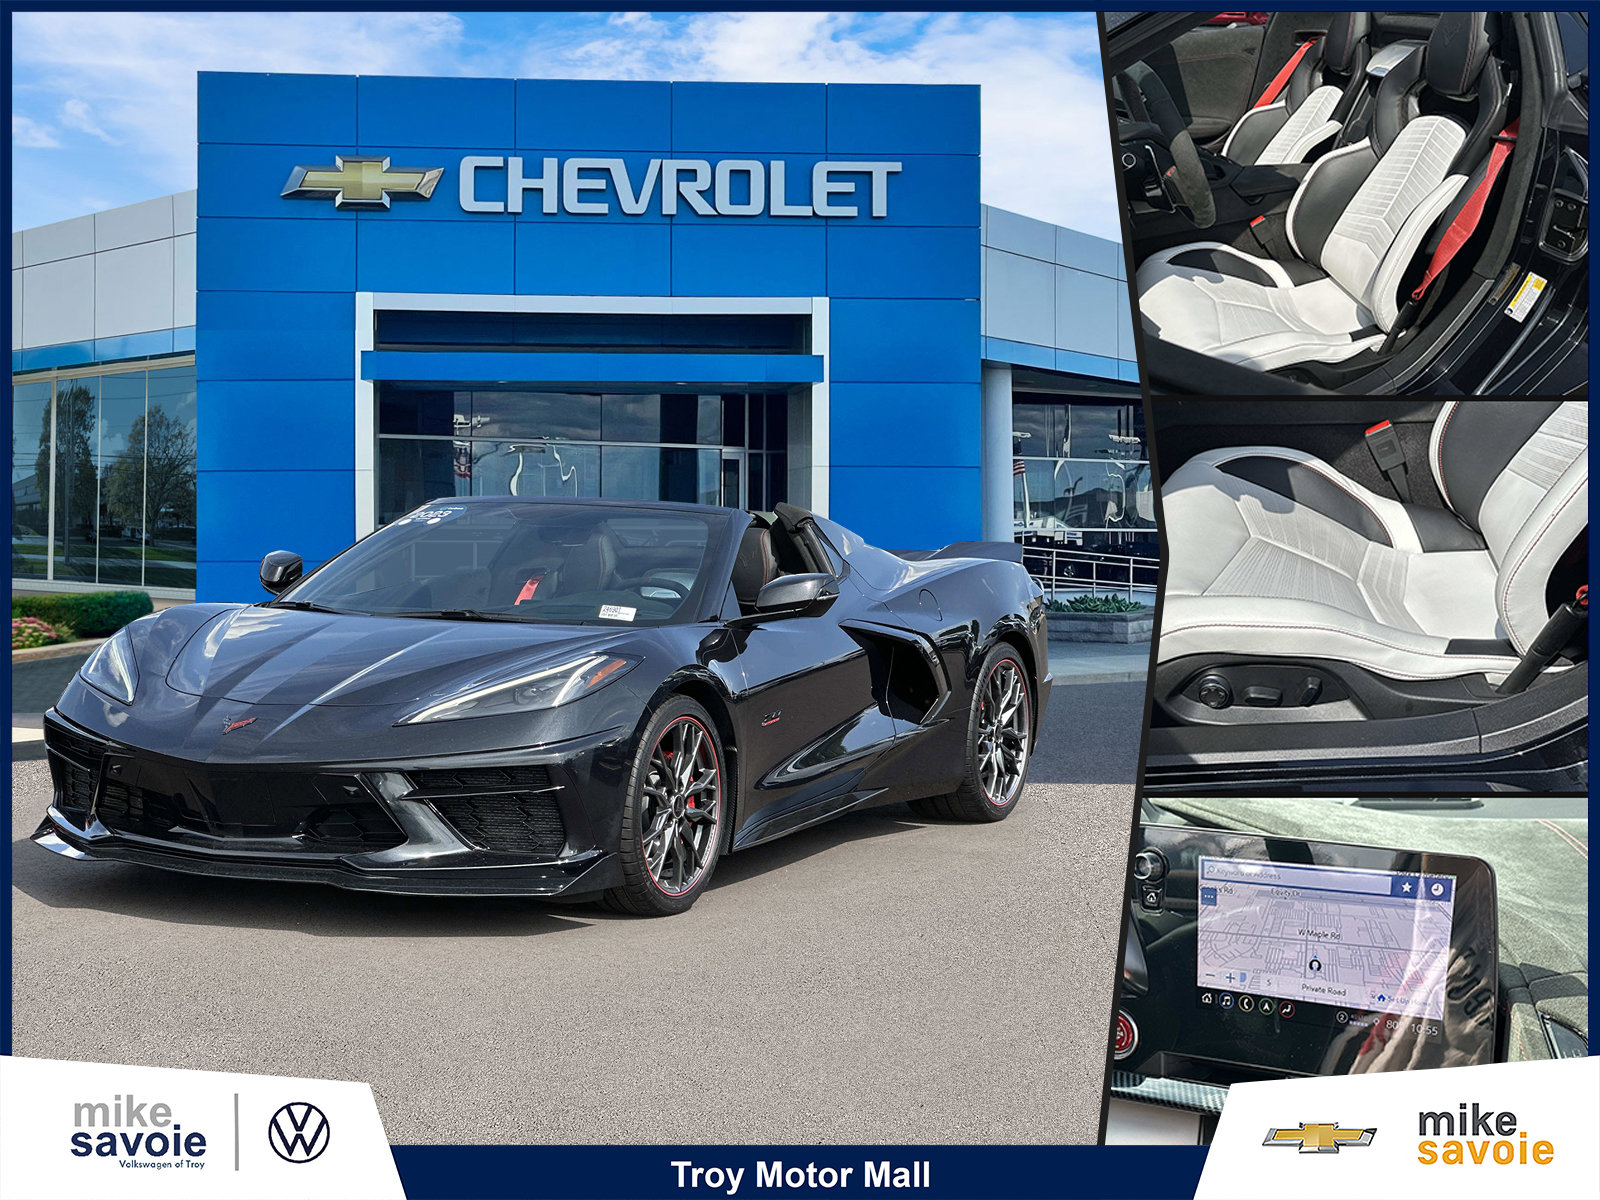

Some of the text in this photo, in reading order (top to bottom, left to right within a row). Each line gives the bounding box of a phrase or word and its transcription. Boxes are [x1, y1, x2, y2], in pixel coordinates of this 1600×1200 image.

[459, 155, 903, 217] CHEVROLET
[1271, 887, 1291, 898] Equity
[1298, 928, 1341, 940] W Maple Rd
[1301, 983, 1347, 997] Private Road
